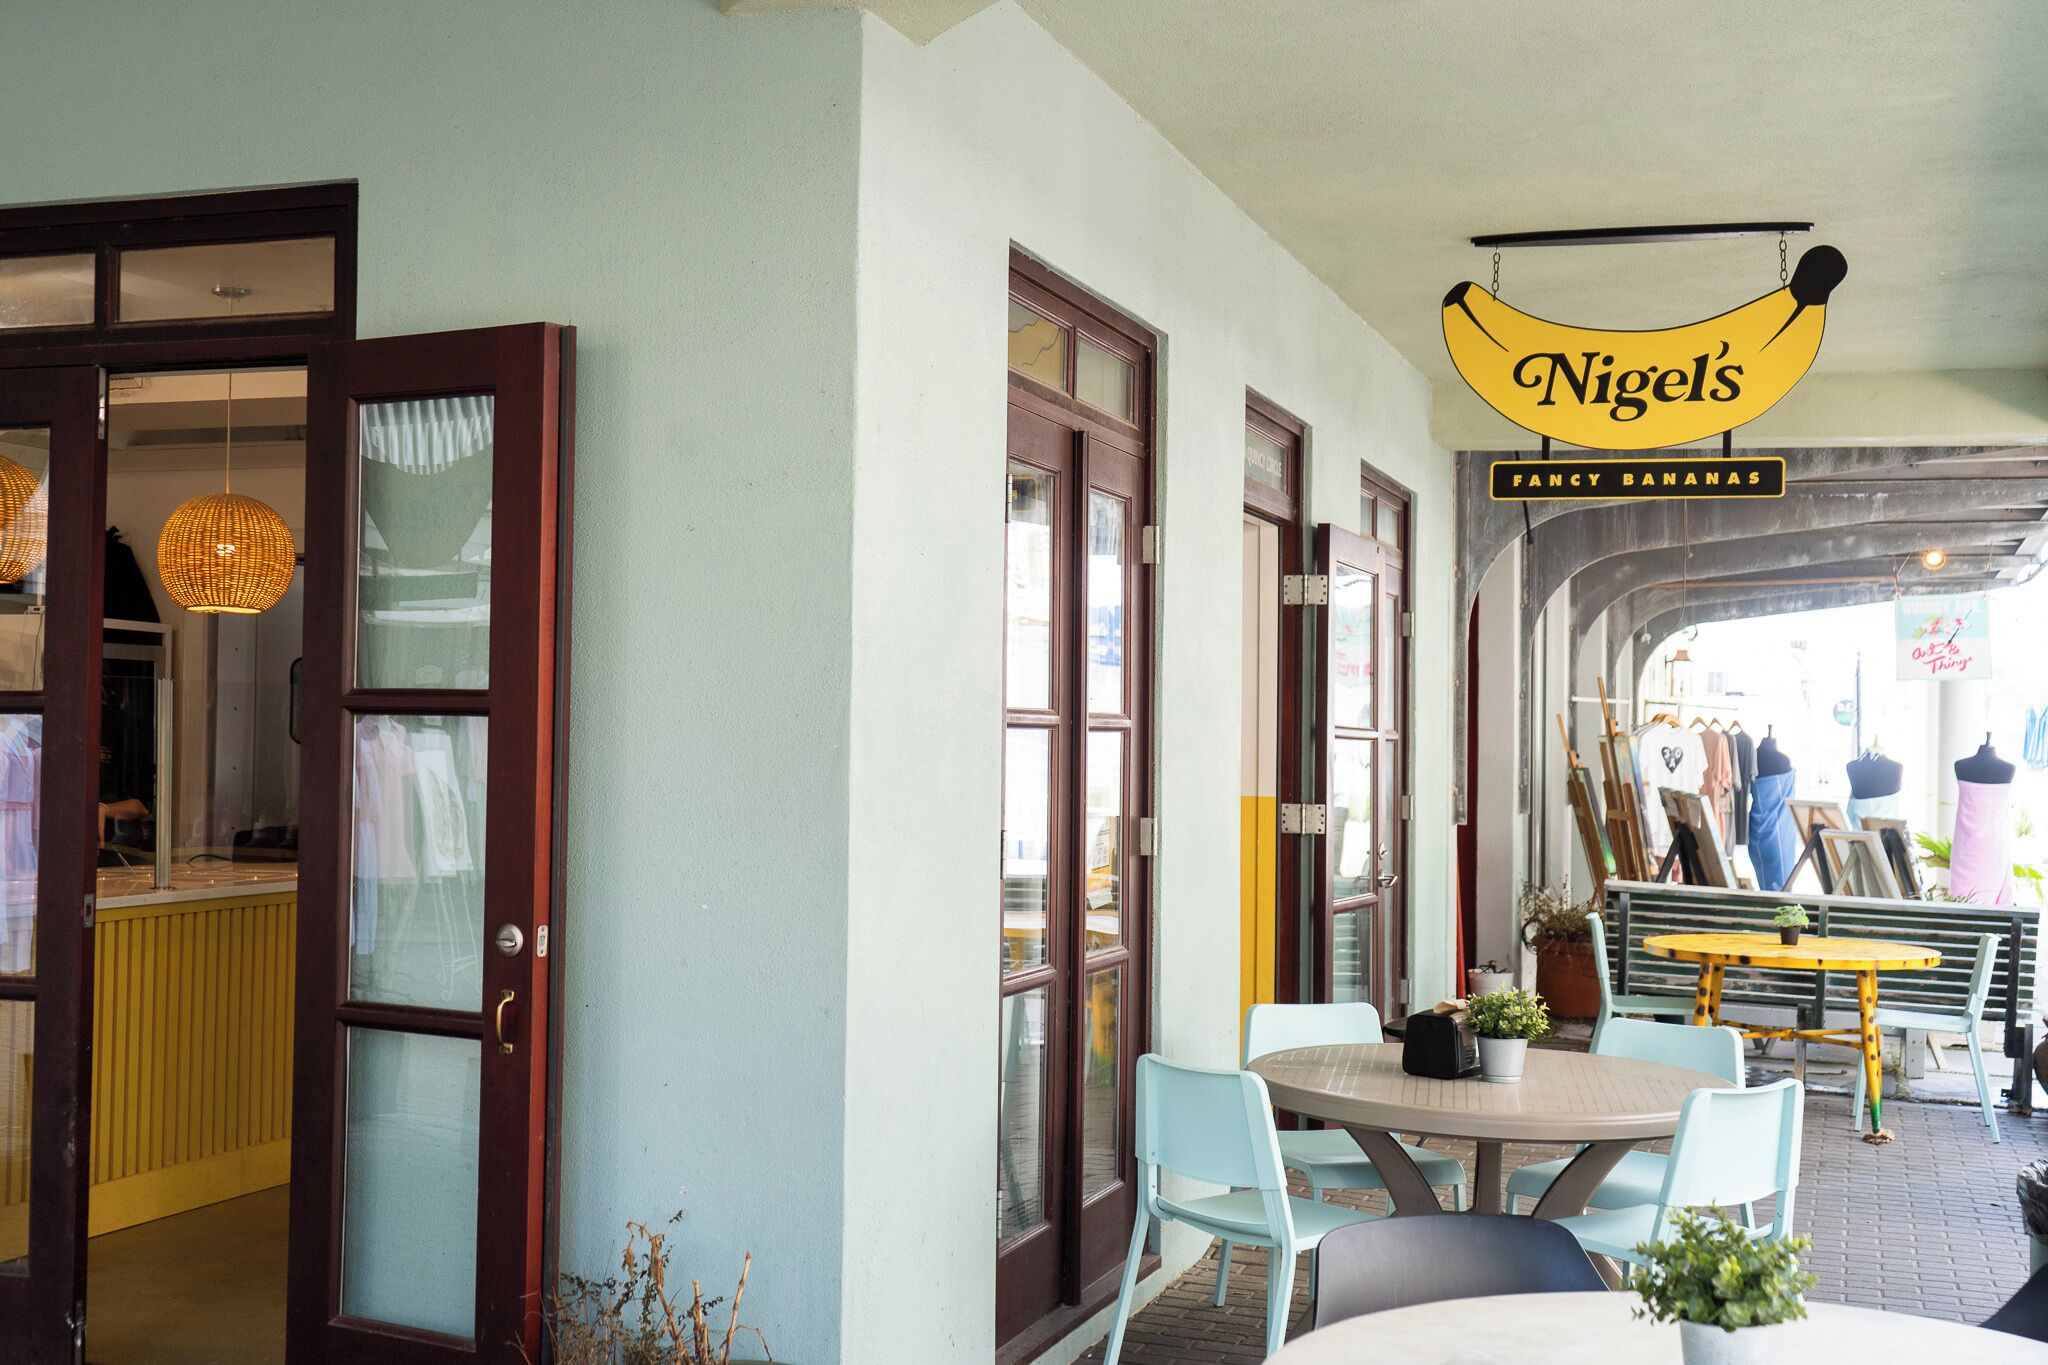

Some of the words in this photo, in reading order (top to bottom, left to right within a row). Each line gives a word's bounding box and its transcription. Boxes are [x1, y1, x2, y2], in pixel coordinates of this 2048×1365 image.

[1512, 340, 1744, 422] Nigel's
[1513, 473, 1601, 487] FANCY
[1623, 471, 1761, 486] BANANAS
